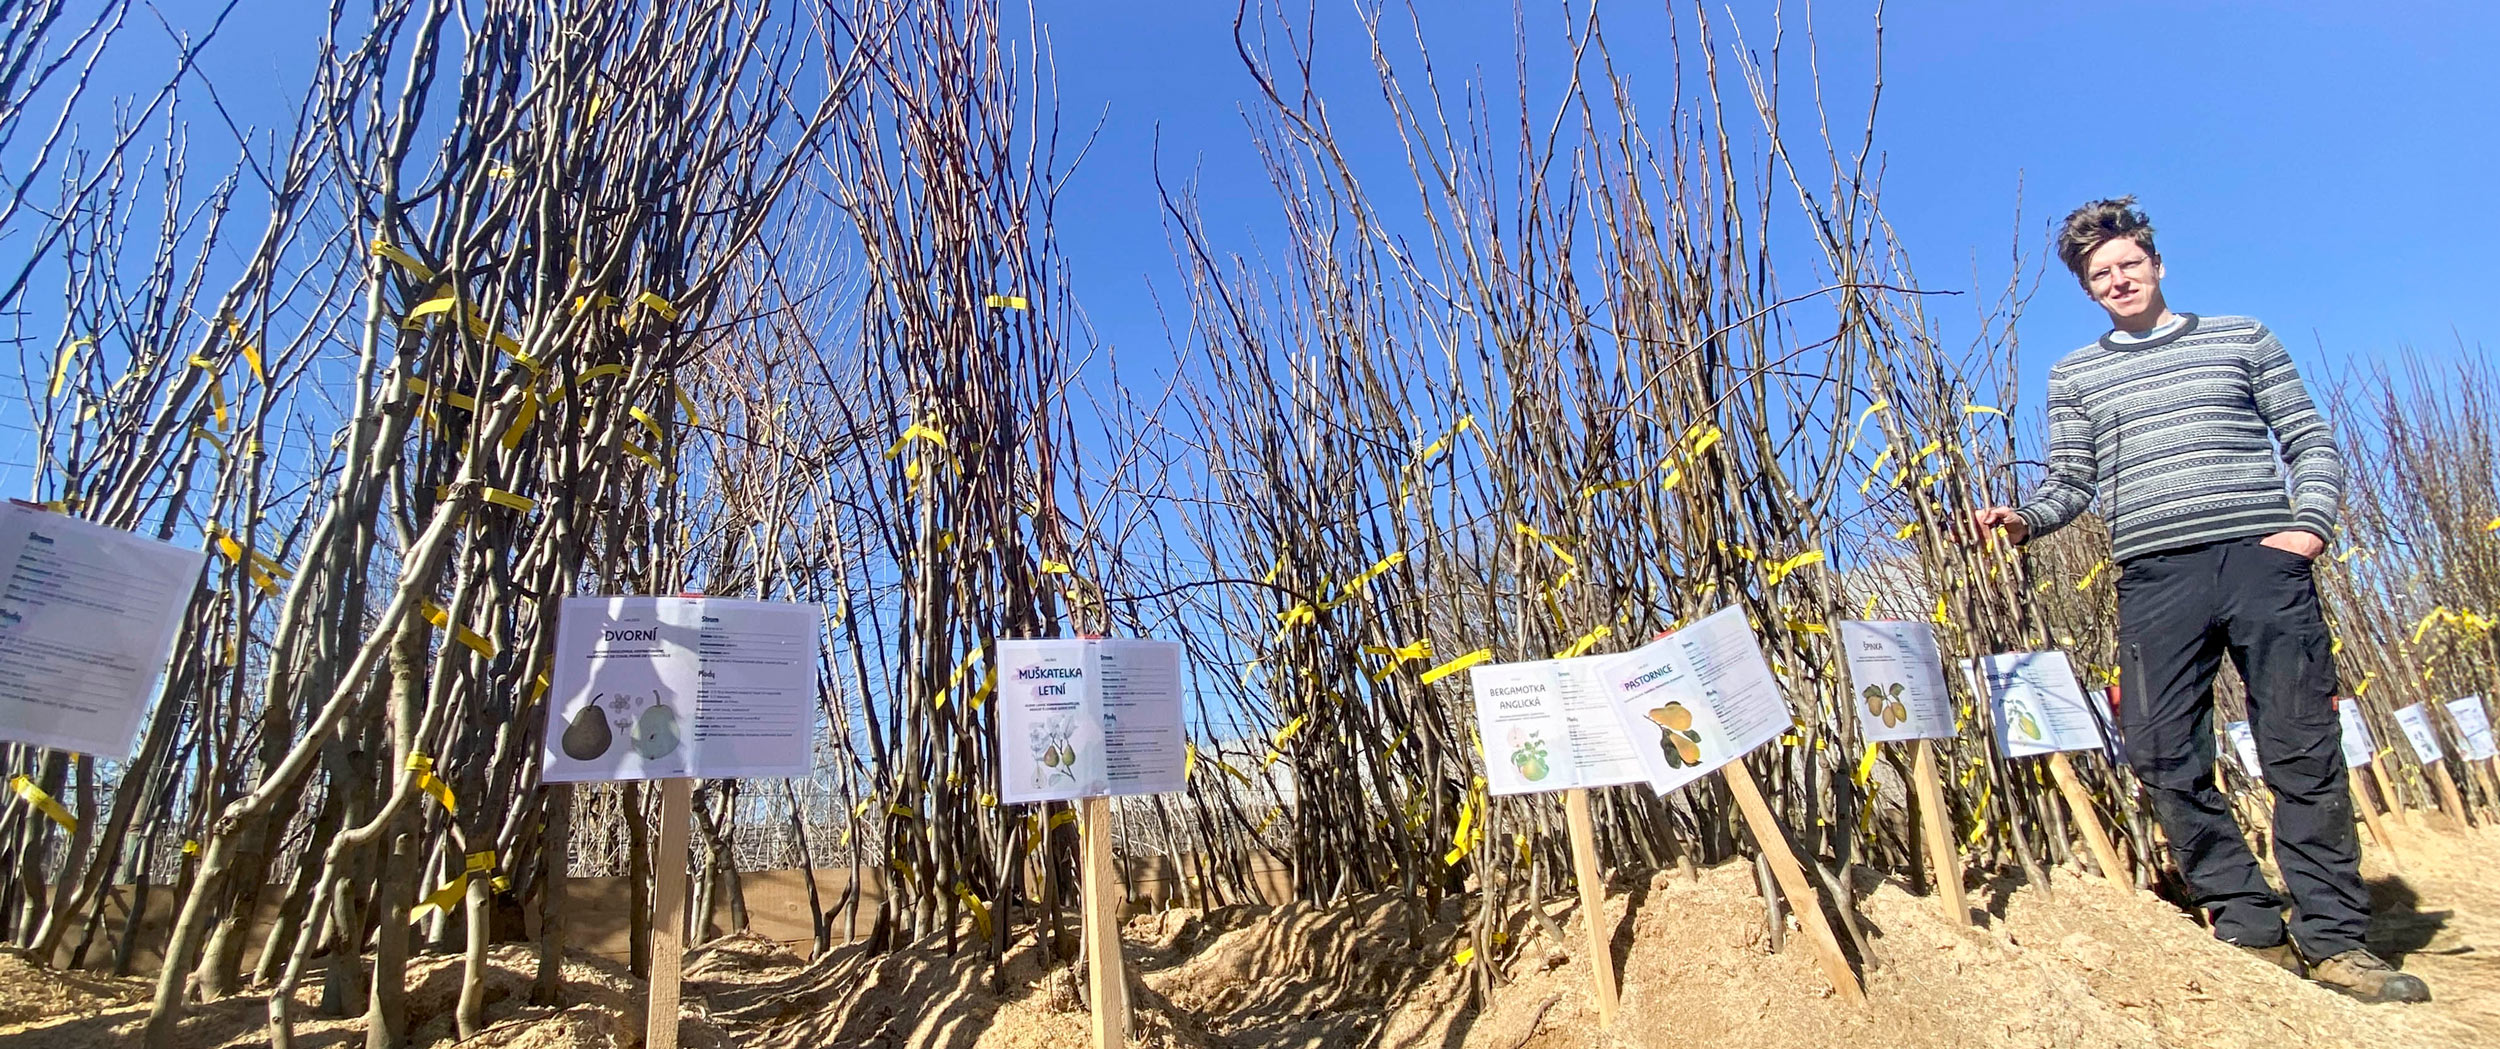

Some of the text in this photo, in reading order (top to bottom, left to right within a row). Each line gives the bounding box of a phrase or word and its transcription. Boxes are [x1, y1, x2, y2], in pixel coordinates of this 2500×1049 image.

[605, 627, 658, 641] DVORNÍ
[1863, 641, 1883, 651] ŠPINKA
[1019, 666, 1082, 679] MUŠKATELKA
[1624, 664, 1673, 691] PASTORNICE
[1039, 682, 1066, 696] LETNÍ
[1489, 684, 1546, 697] BERGAMOTKA
[1500, 696, 1541, 710] ANGLICKÁ
